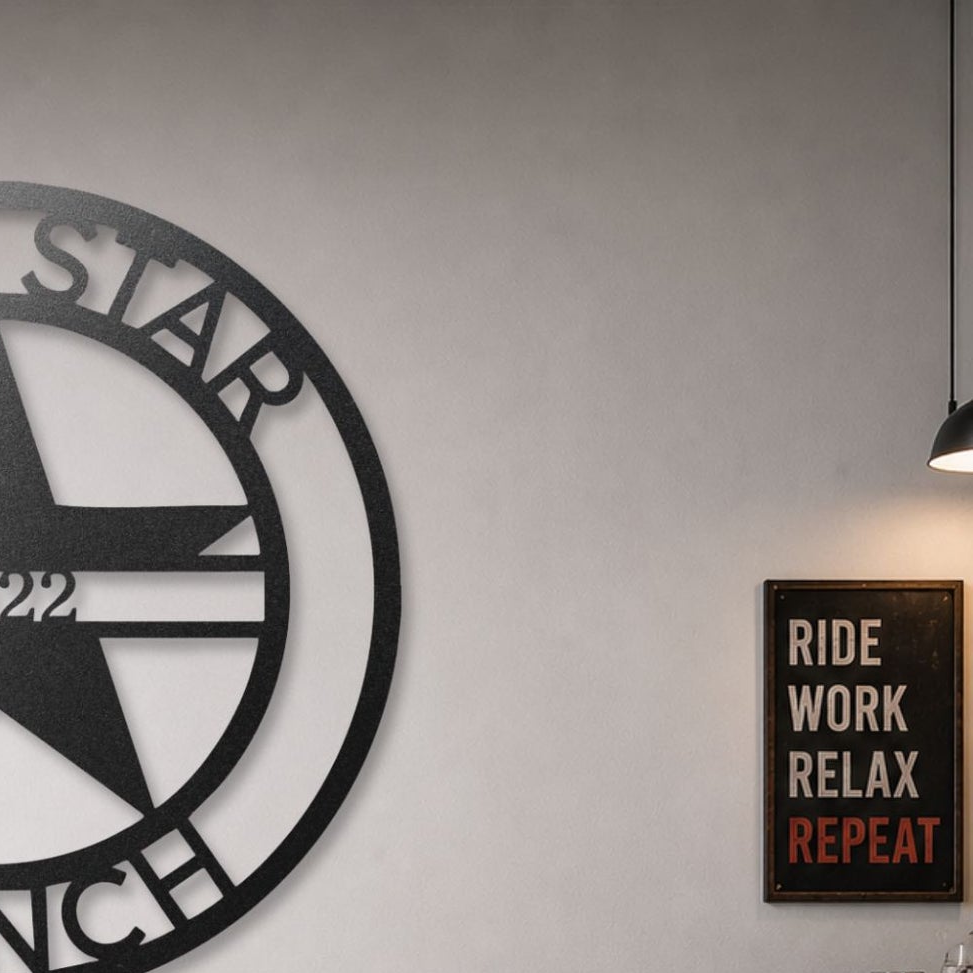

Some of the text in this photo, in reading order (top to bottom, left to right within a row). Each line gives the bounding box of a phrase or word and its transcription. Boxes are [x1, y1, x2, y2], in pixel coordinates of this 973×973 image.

[20, 212, 306, 442] STAR
[788, 618, 882, 666] RIDE
[787, 685, 908, 731] WORK
[788, 751, 919, 798] RELAX
[788, 816, 941, 864] REPEAT
